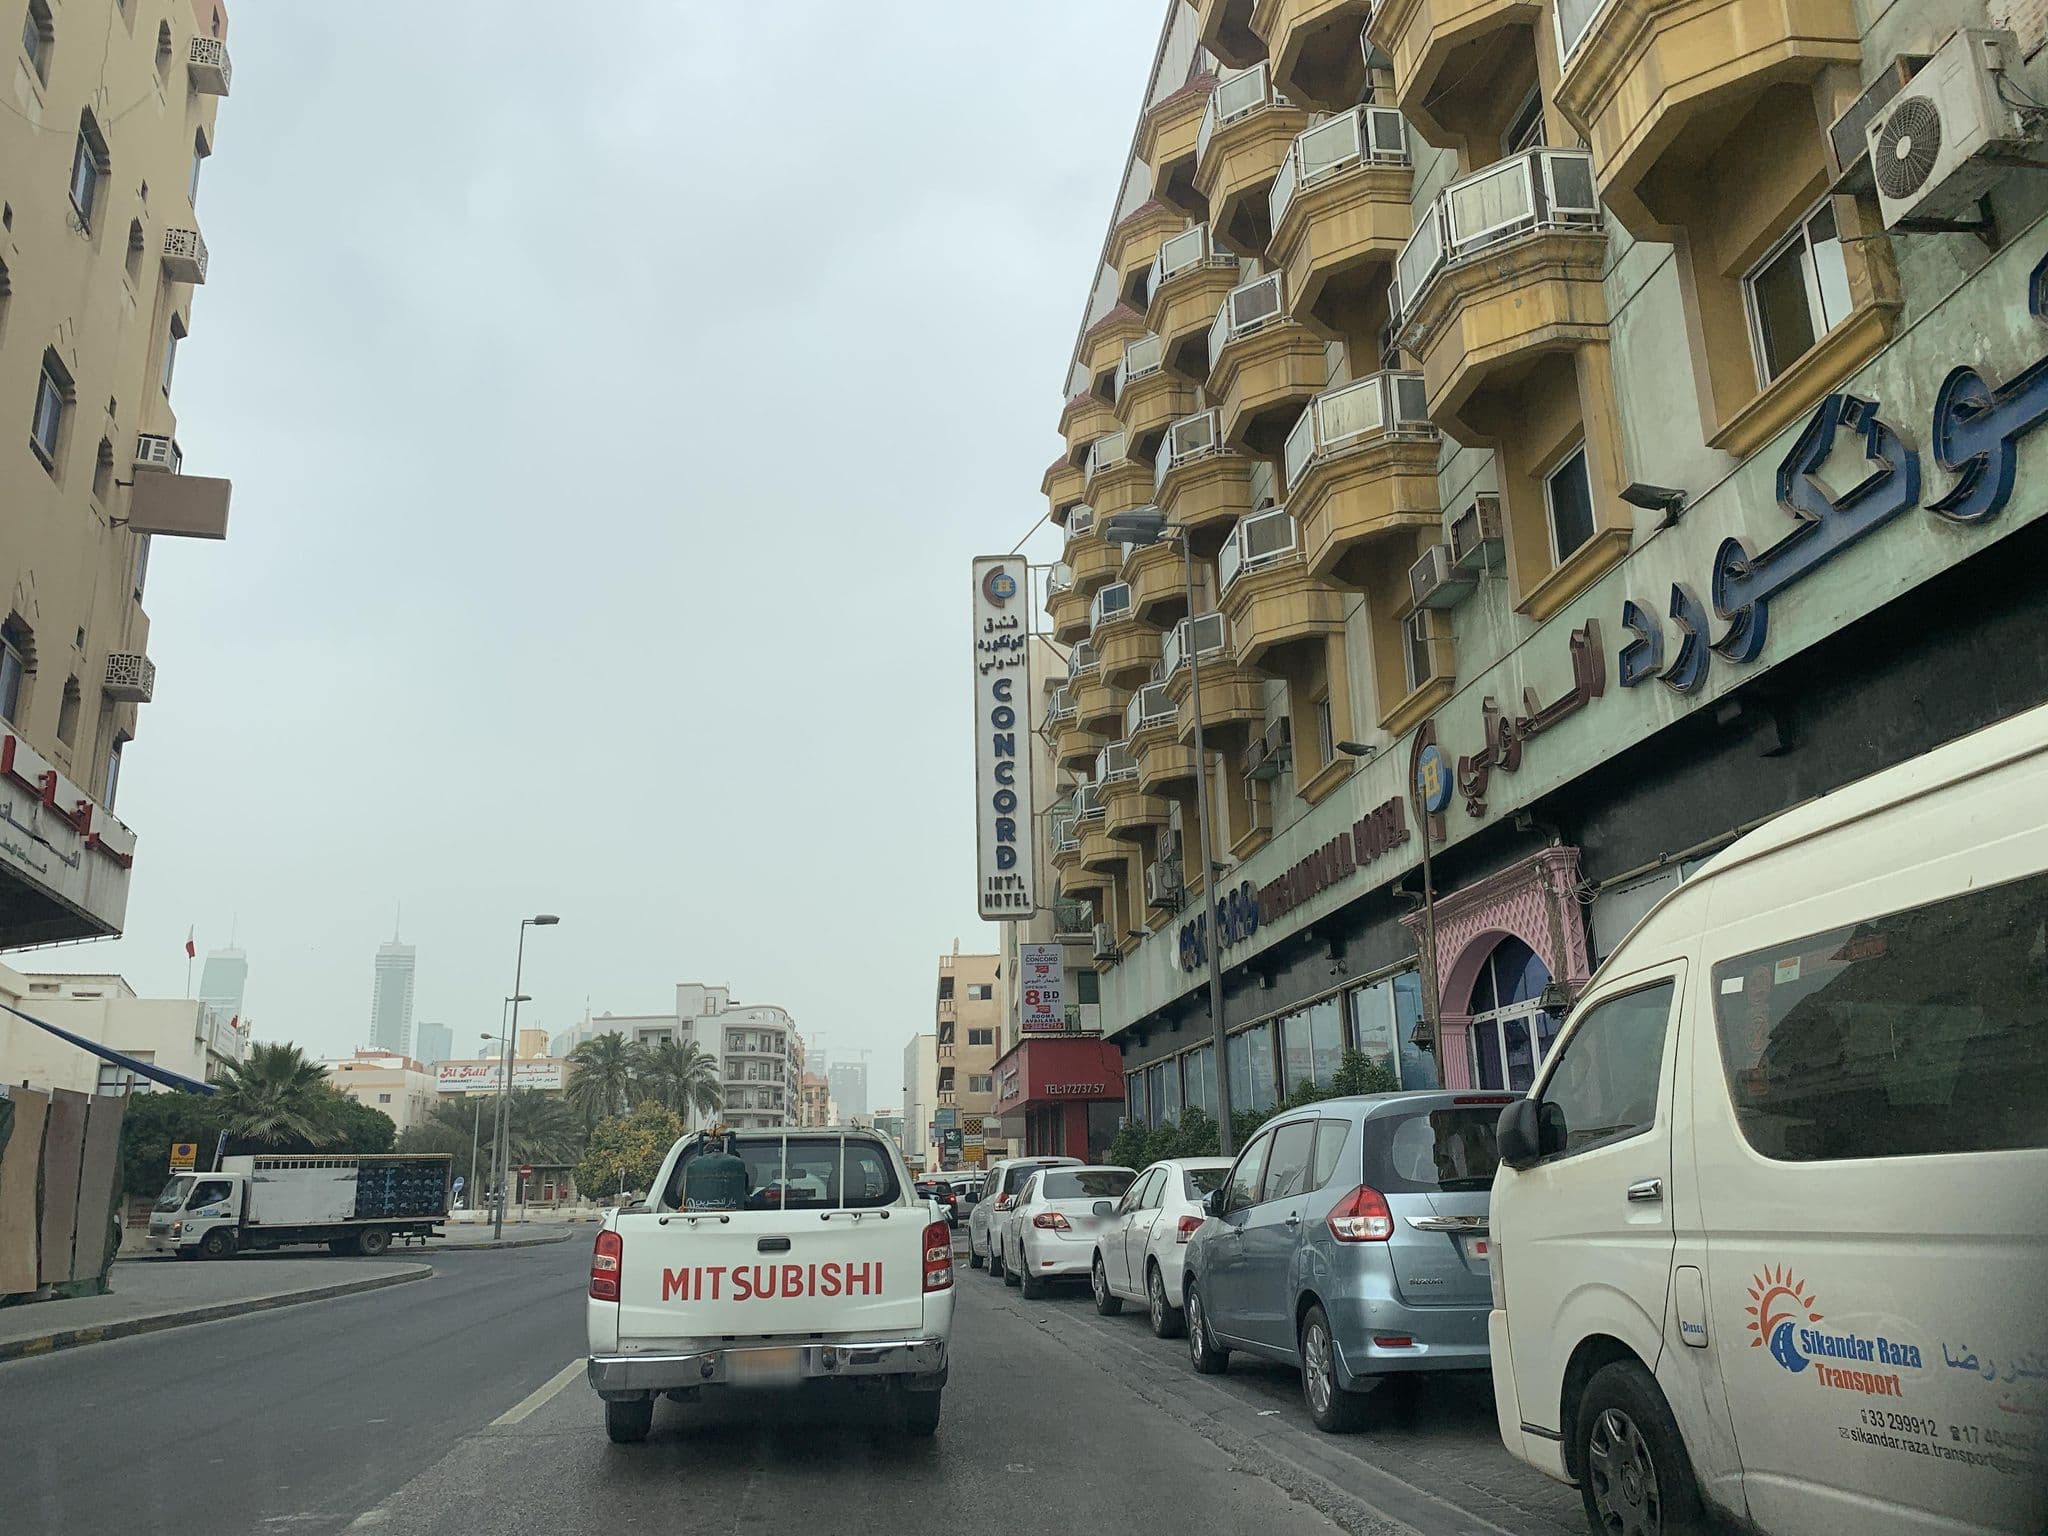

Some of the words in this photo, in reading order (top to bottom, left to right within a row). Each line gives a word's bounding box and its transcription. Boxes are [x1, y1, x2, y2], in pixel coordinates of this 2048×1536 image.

[983, 615, 1018, 633] فندق
[978, 634, 1025, 652] كونكورد
[979, 653, 1025, 675] الدولي
[991, 678, 1018, 870] CONCORD
[988, 873, 1025, 890] INT'L
[984, 893, 1030, 908] HOTEL
[1025, 990, 1040, 1006] 8
[1043, 991, 1060, 999] BD
[662, 1262, 883, 1301] MITSUBISHI
[1800, 1329, 1875, 1362] Sikandar
[1876, 1337, 1922, 1368] Raza
[1815, 1363, 1903, 1397] Transport
[1869, 1409, 1885, 1428] 33
[1887, 1412, 1938, 1438] 299912
